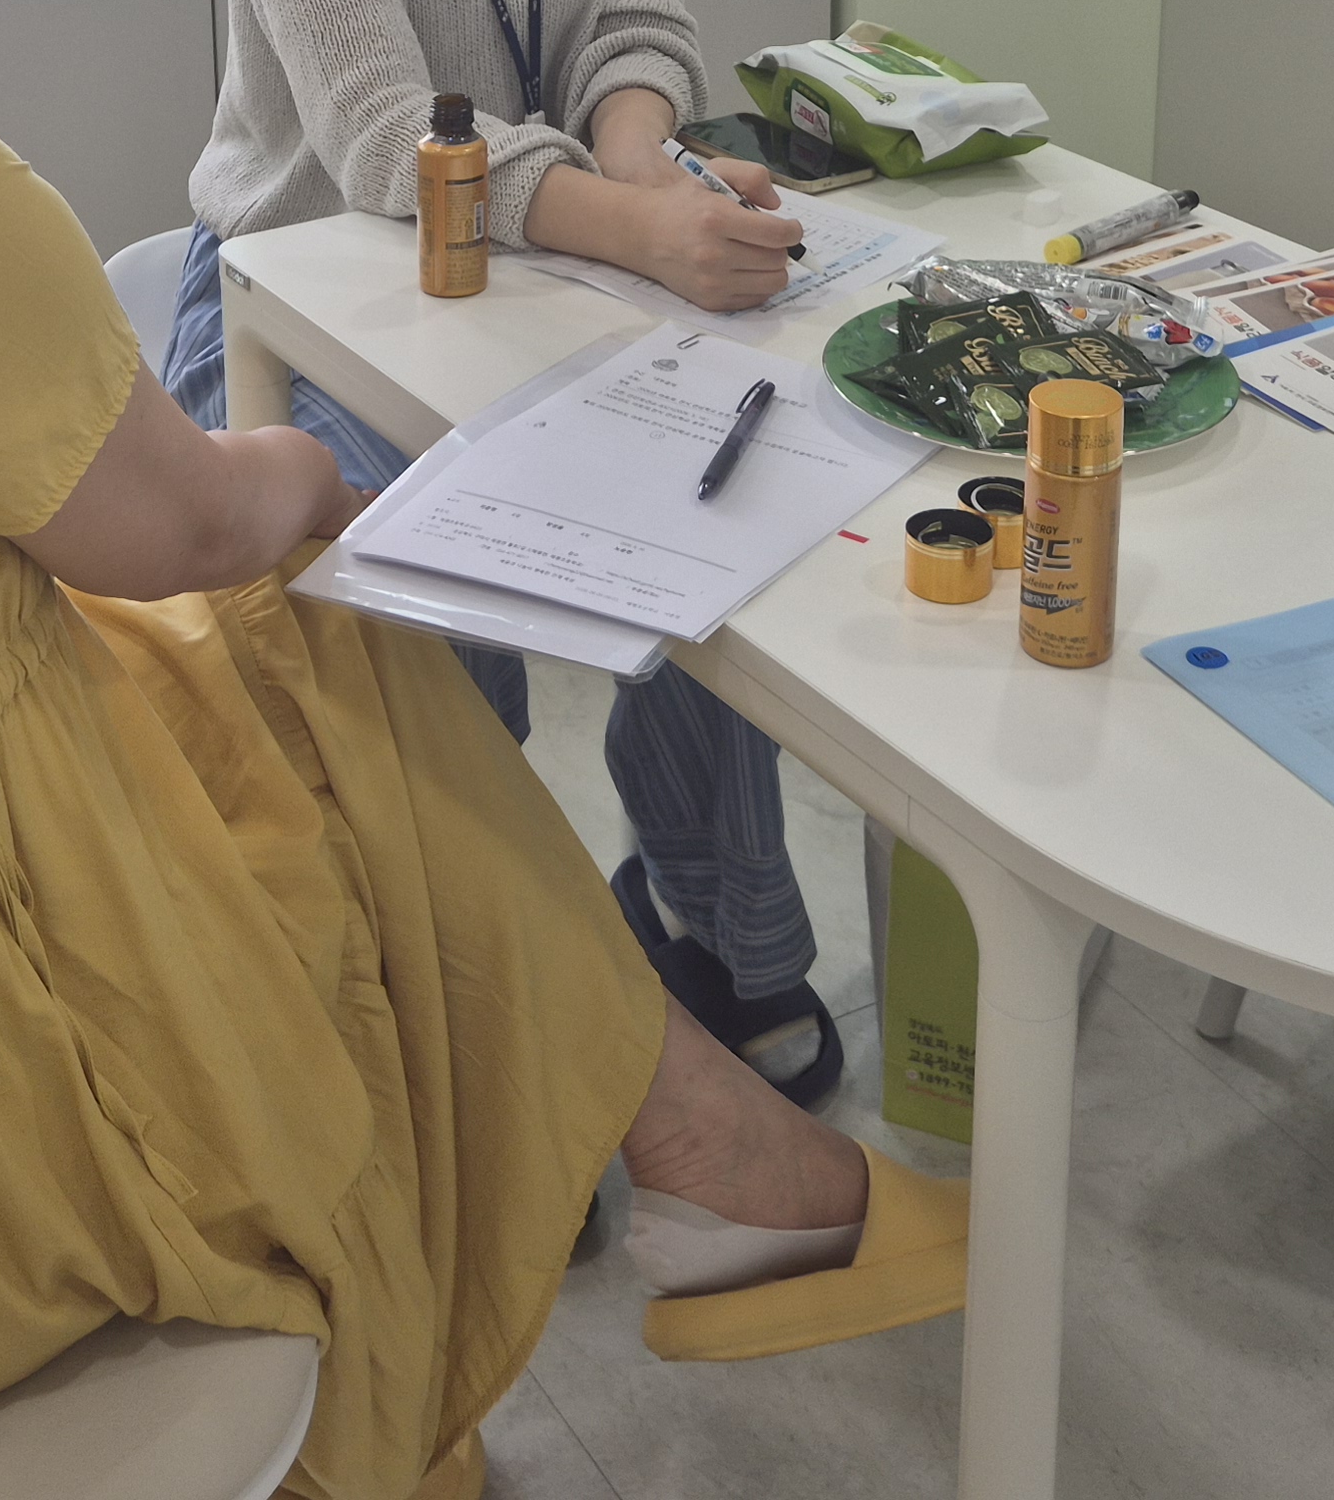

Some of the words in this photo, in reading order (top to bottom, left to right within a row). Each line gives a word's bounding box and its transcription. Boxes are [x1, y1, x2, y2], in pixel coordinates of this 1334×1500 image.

[1023, 533, 1072, 575] 골드
[1057, 581, 1078, 590] free
[918, 1071, 974, 1095] 1899-75
